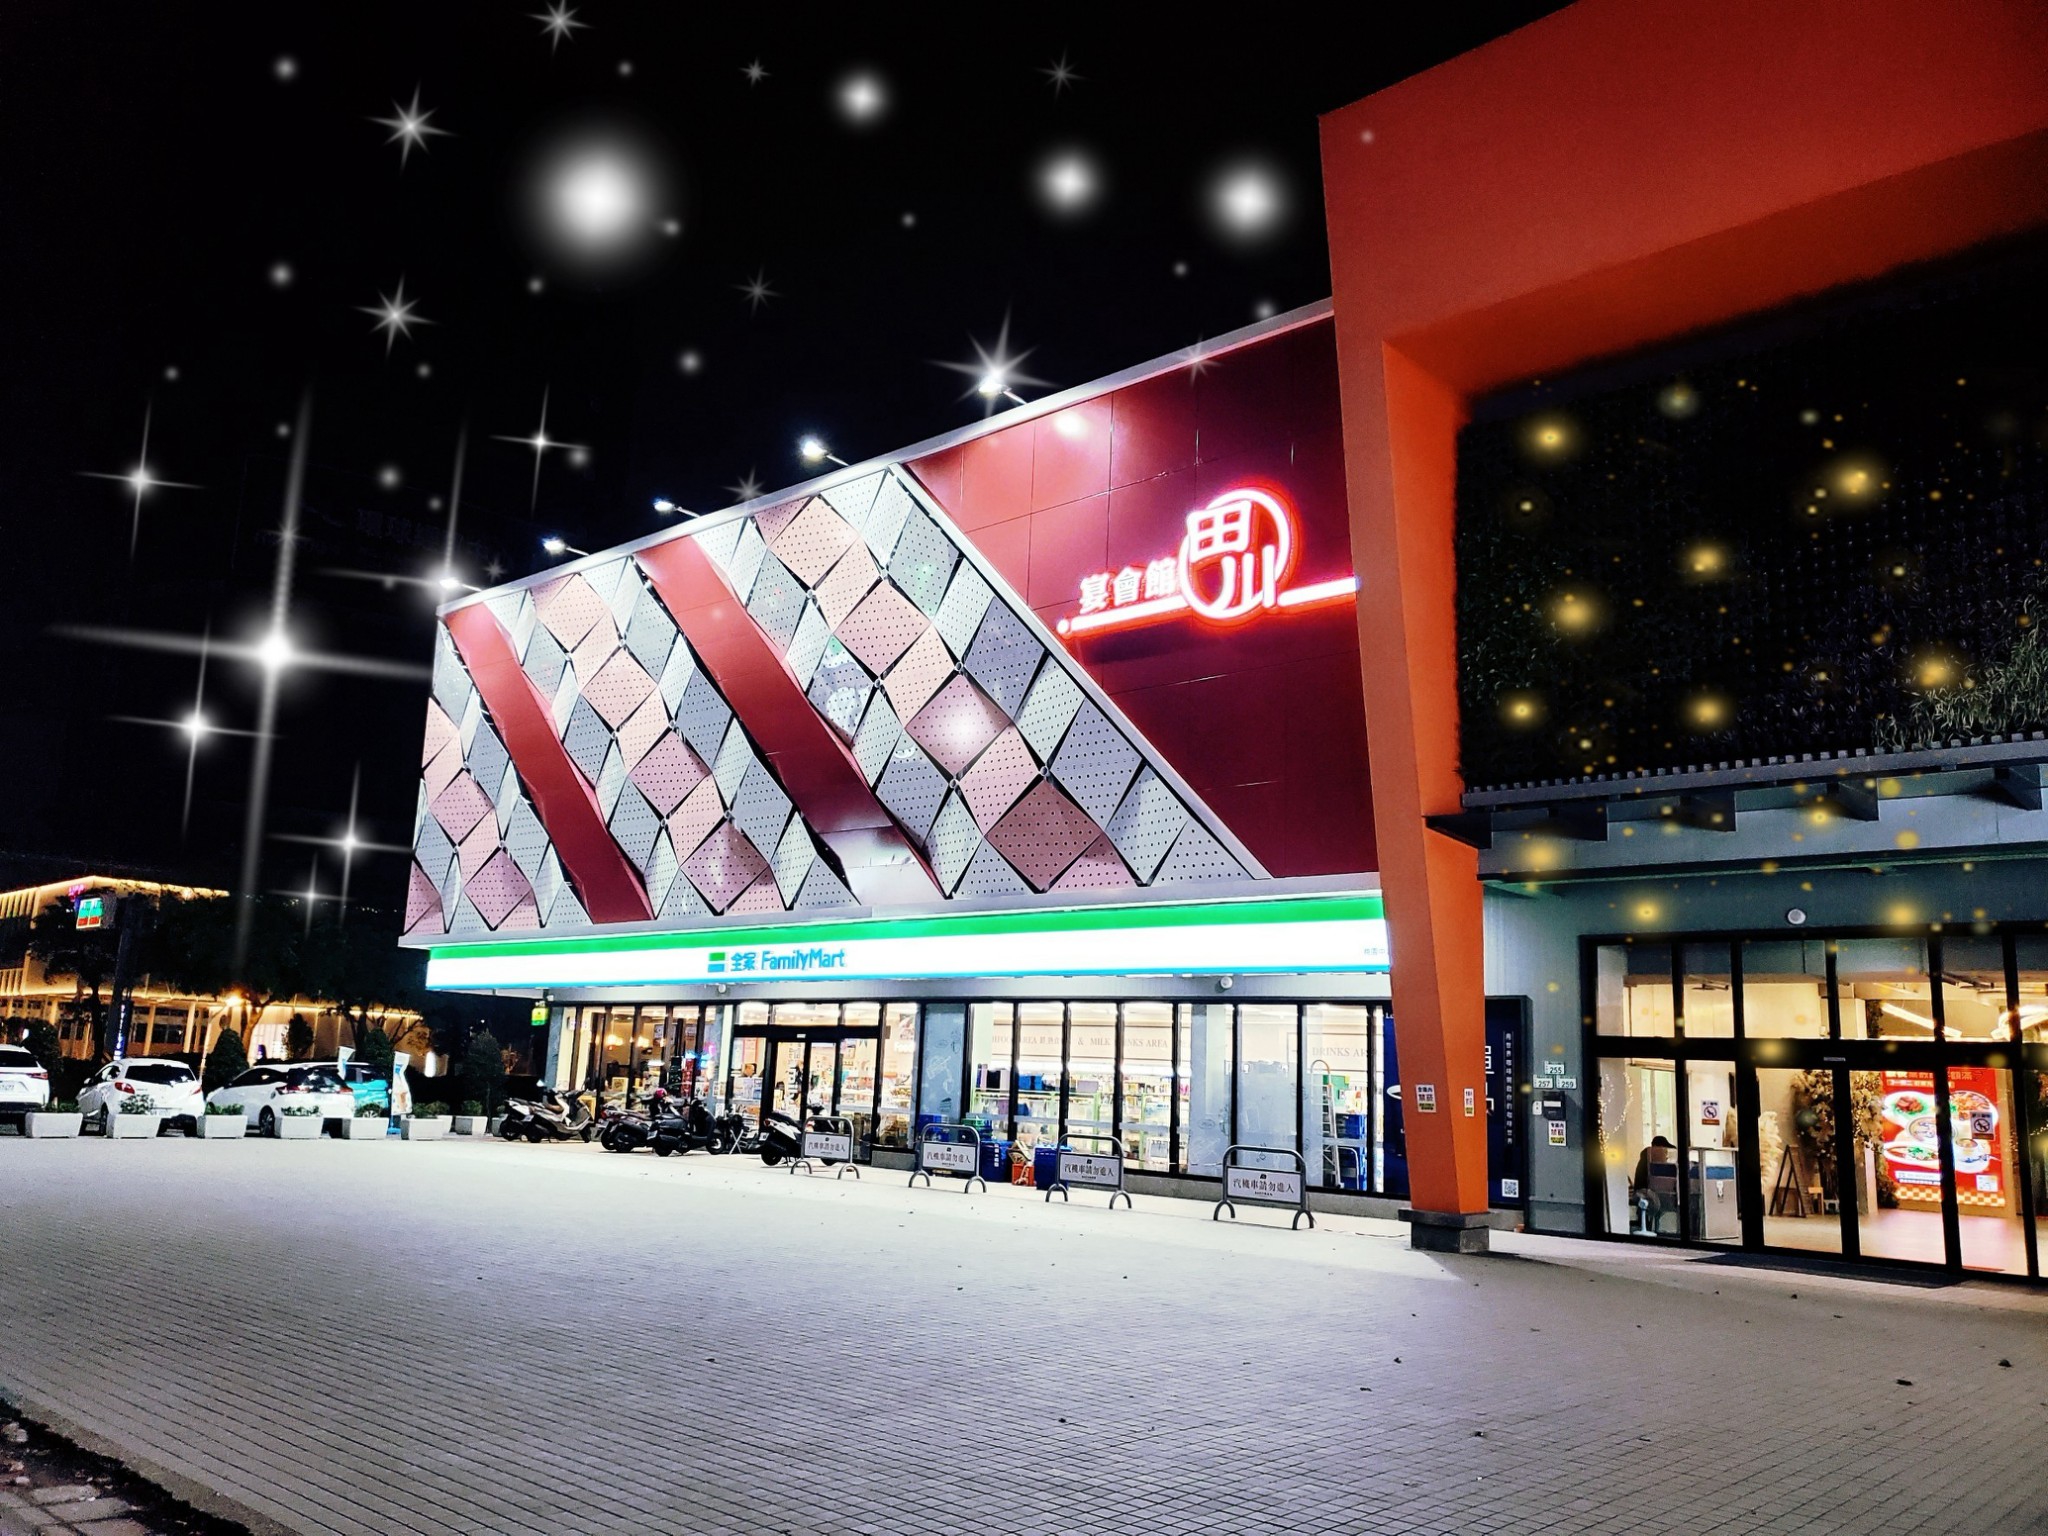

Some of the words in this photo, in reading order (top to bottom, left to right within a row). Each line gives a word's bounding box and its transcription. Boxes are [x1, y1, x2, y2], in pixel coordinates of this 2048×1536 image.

[1079, 557, 1177, 614] 宴會館
[731, 952, 757, 972] 全家
[761, 948, 846, 971] FamilyMart
[1090, 1037, 1111, 1046] MILK
[1311, 1047, 1350, 1057] DRINKS
[1549, 1066, 1562, 1074] 255
[1538, 1080, 1550, 1088] 257
[1233, 1178, 1294, 1194] 汽機車請勿進入
